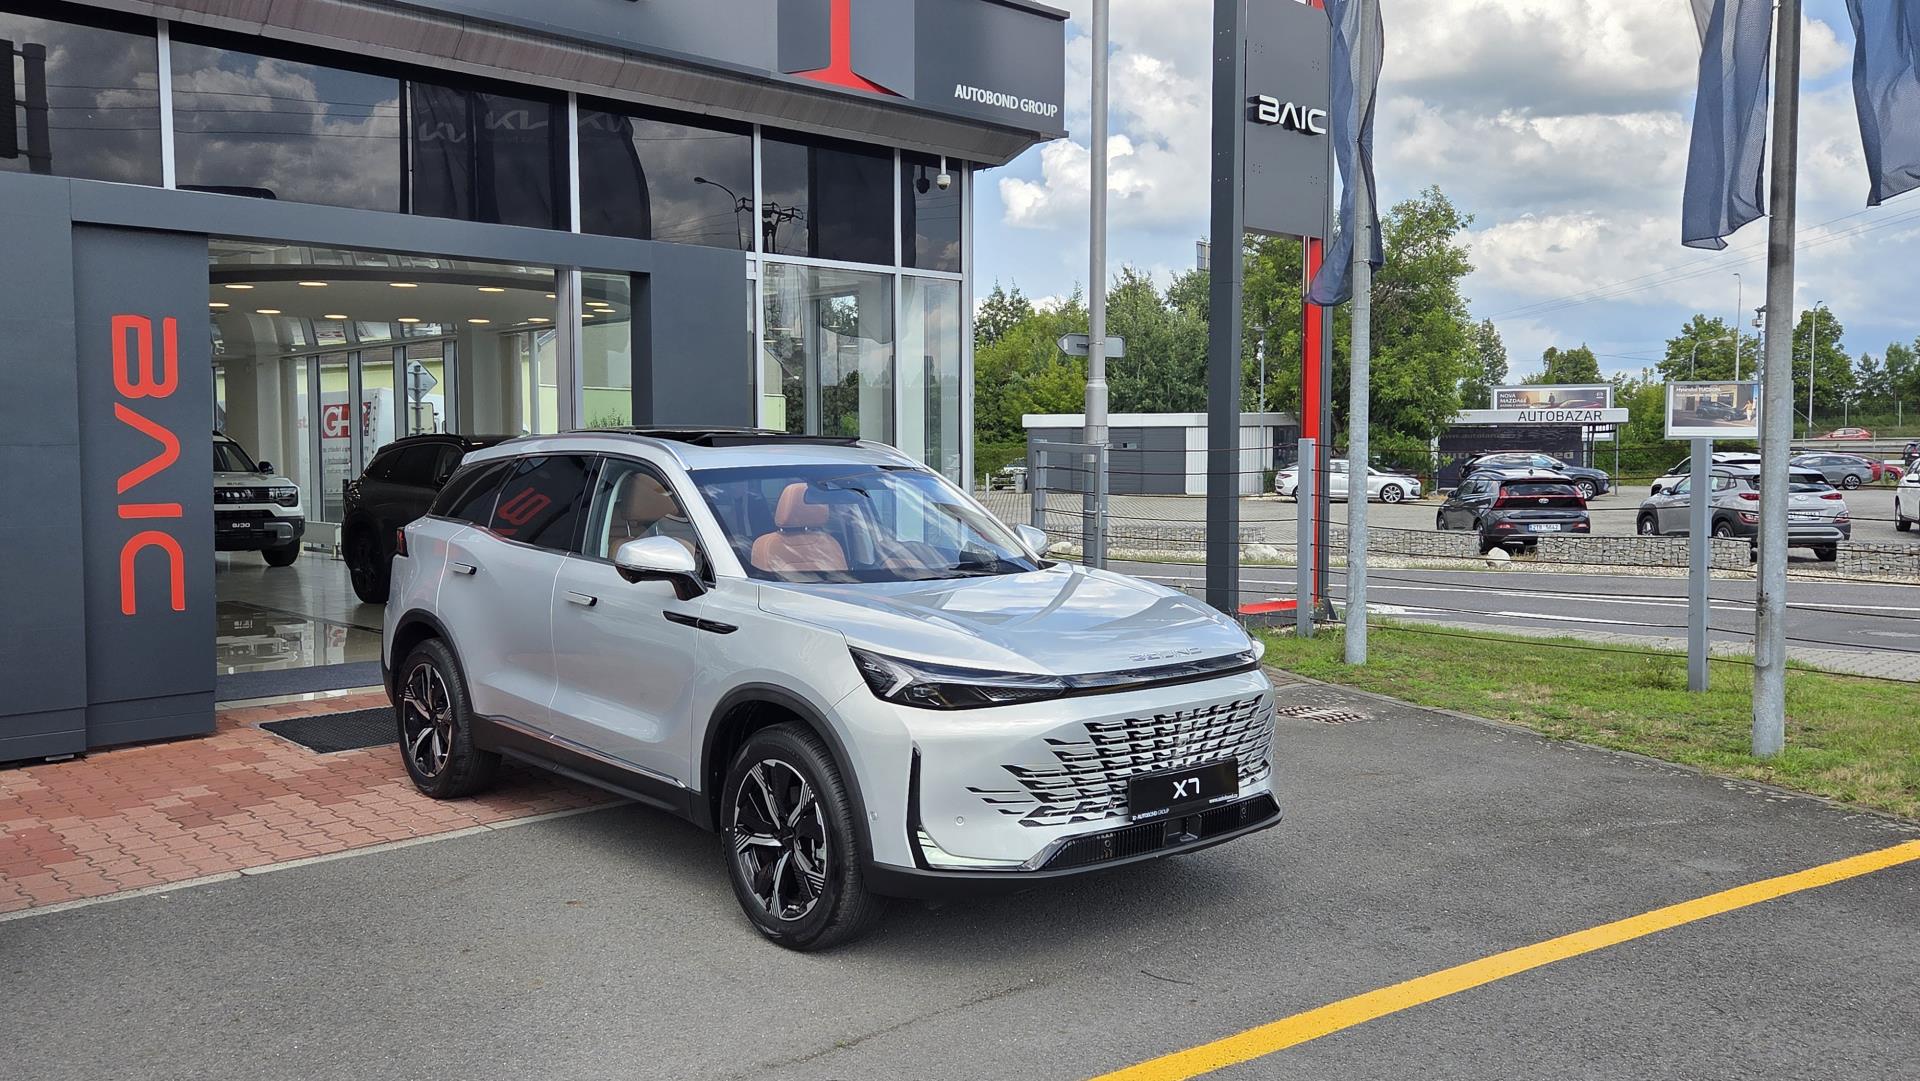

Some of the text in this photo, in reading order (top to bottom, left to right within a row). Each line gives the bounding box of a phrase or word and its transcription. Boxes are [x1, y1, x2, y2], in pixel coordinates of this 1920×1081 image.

[954, 84, 1058, 118] AUTOBOND GROUP
[1258, 94, 1327, 135] BAIC
[1518, 410, 1602, 422] AUTOBAZAR
[111, 315, 185, 615] BAIC
[1173, 777, 1200, 800] X7
